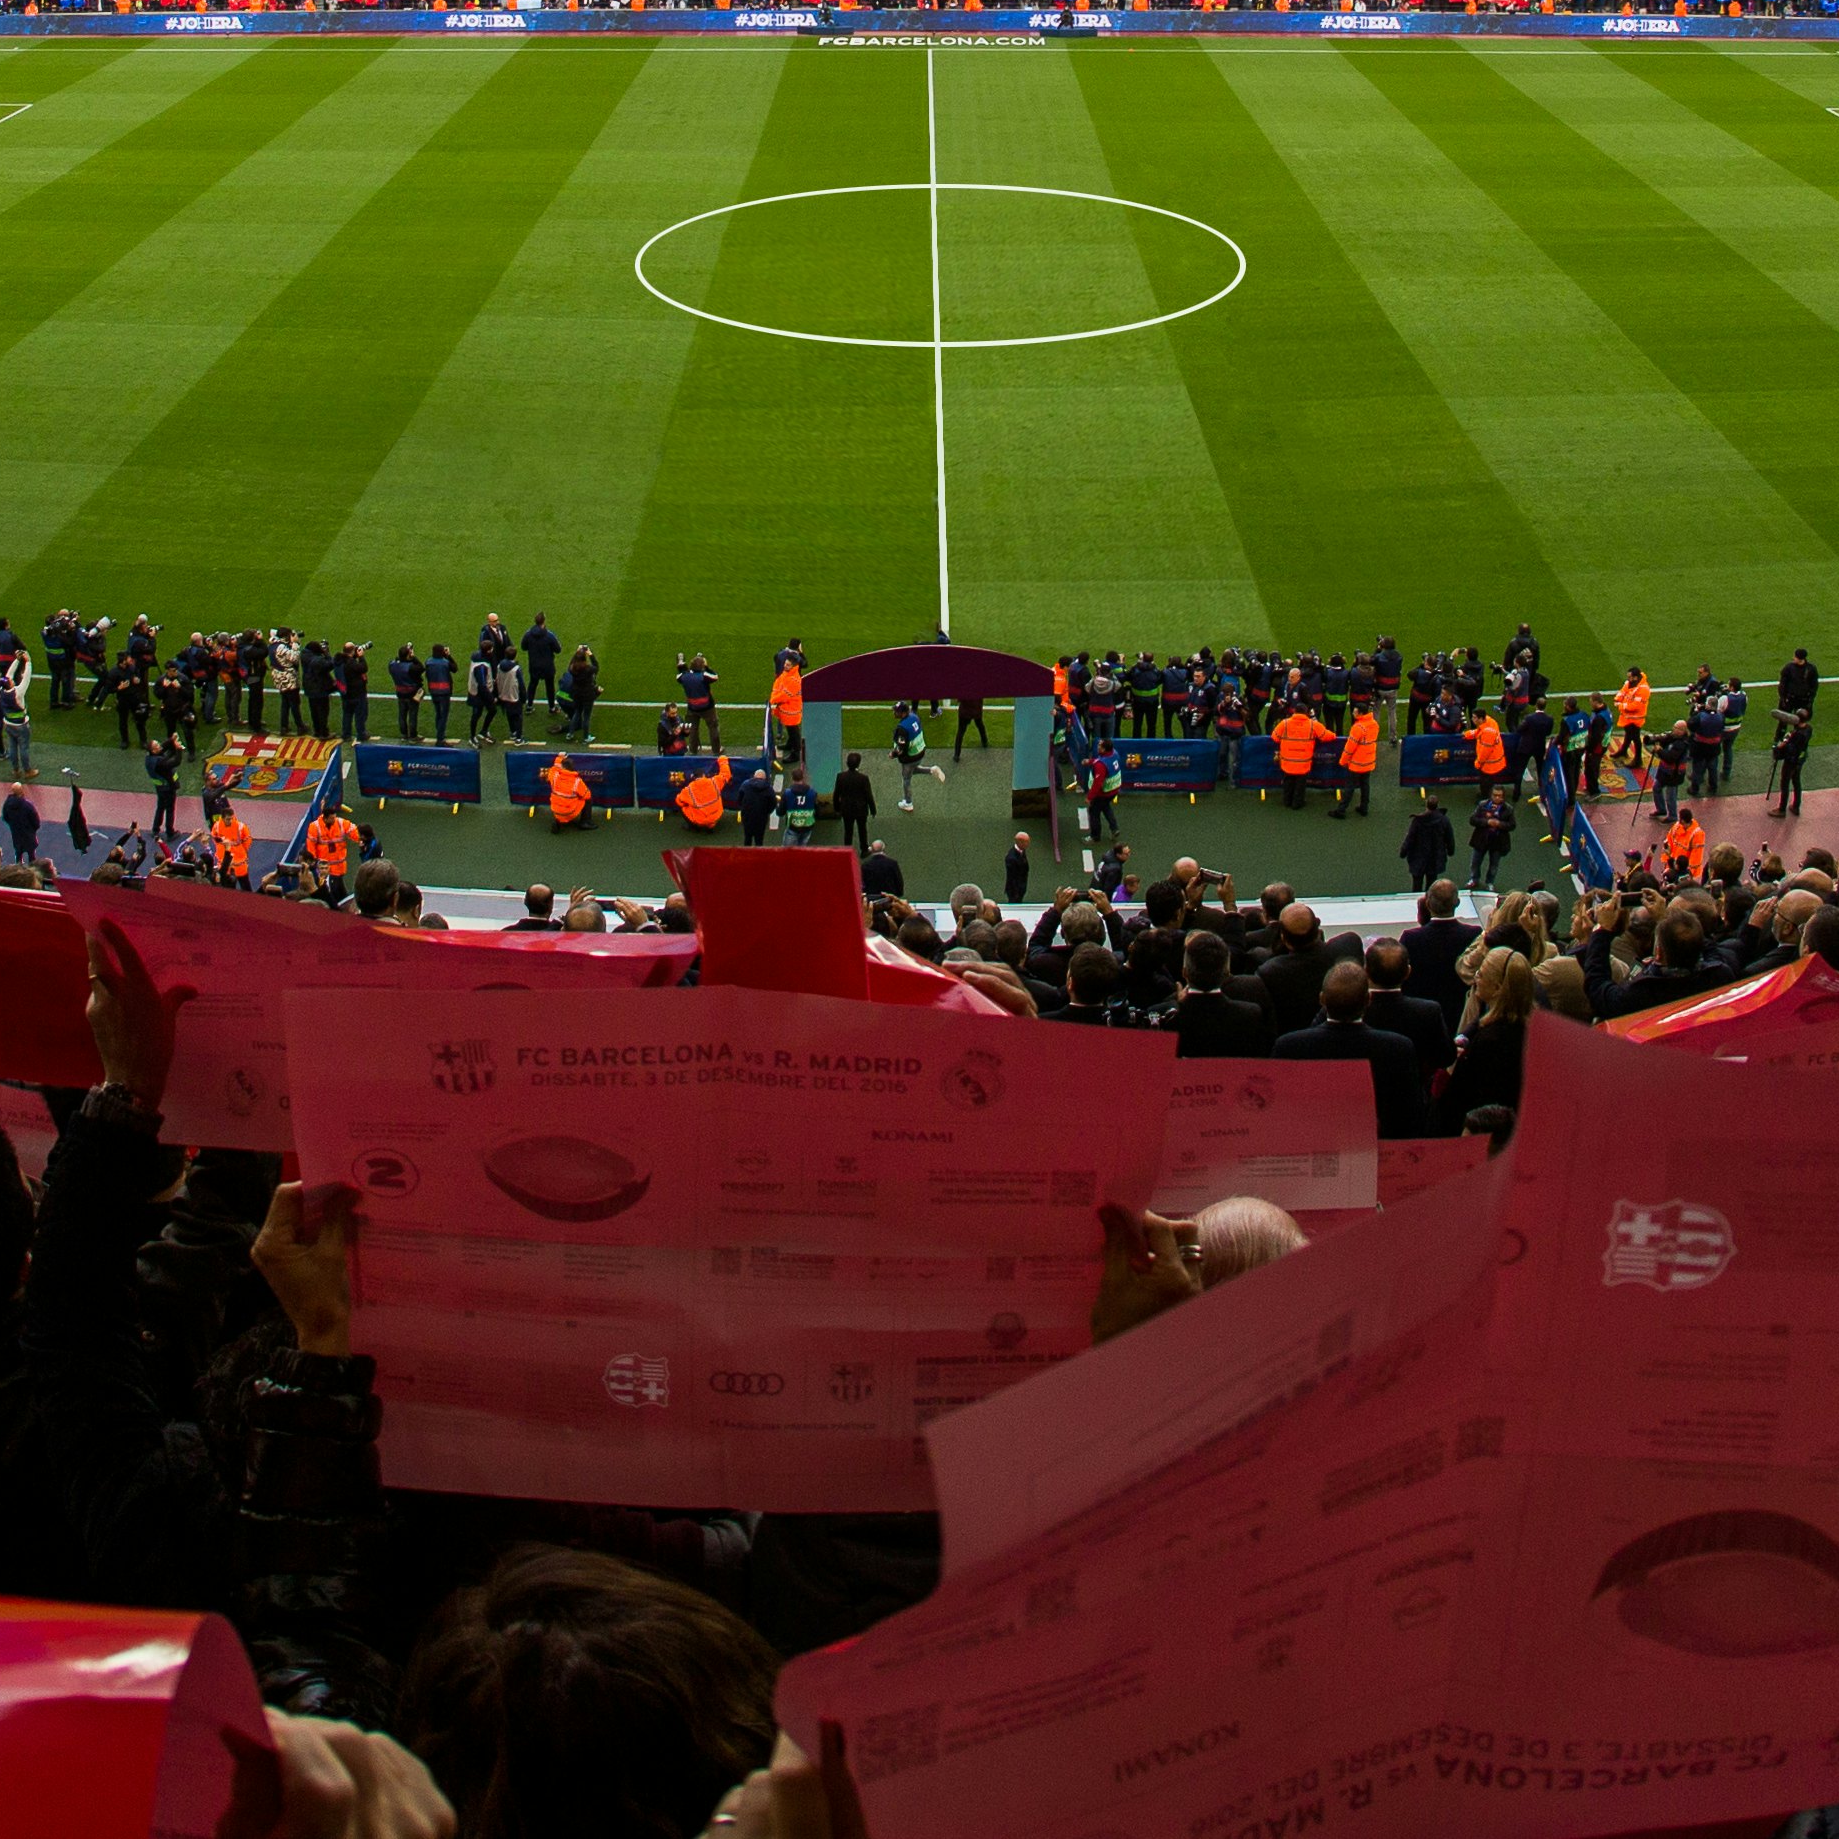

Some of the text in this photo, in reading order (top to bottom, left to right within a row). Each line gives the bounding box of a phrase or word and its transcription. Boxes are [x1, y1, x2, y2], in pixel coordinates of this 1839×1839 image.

[818, 37, 1046, 47] FCBARCELONA.COM
[247, 757, 296, 768] FCB
[796, 795, 806, 805] TJ
[516, 1046, 550, 1067] FC
[560, 1041, 734, 1067] BARCELONA
[773, 1049, 800, 1071] R.
[808, 1053, 924, 1077] MADRID
[1807, 1053, 1826, 1066] FC
[530, 1064, 909, 1095] DISSABTE, 3 DE DESEMBRE DEL 2016
[1170, 1083, 1224, 1098] ADRID
[870, 1128, 954, 1144] KONAMI
[365, 1156, 407, 1190] 2
[1506, 1734, 1551, 1760] DE
[1434, 1753, 1717, 1793] BARCELONA
